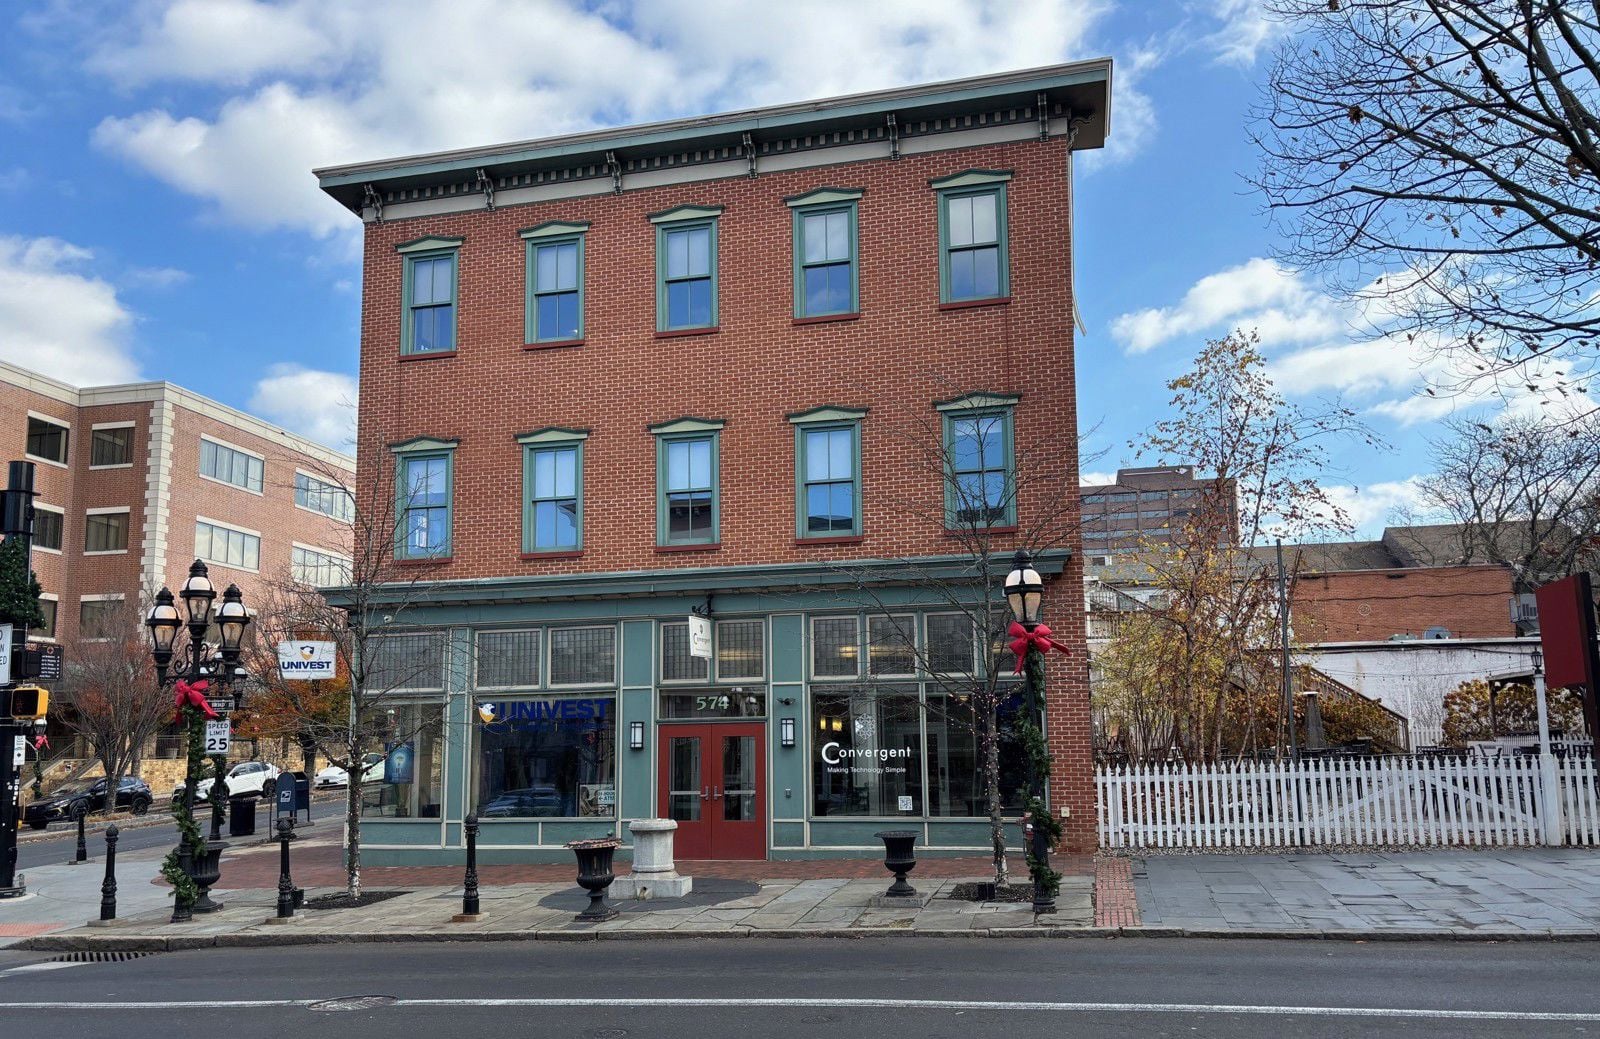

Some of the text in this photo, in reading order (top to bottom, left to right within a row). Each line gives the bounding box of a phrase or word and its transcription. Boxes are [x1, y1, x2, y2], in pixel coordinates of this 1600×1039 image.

[282, 661, 331, 669] UNIVEST
[498, 698, 609, 720] UNIVEST
[696, 695, 730, 710] 574
[207, 738, 228, 751] 25
[821, 742, 911, 765] Convergent
